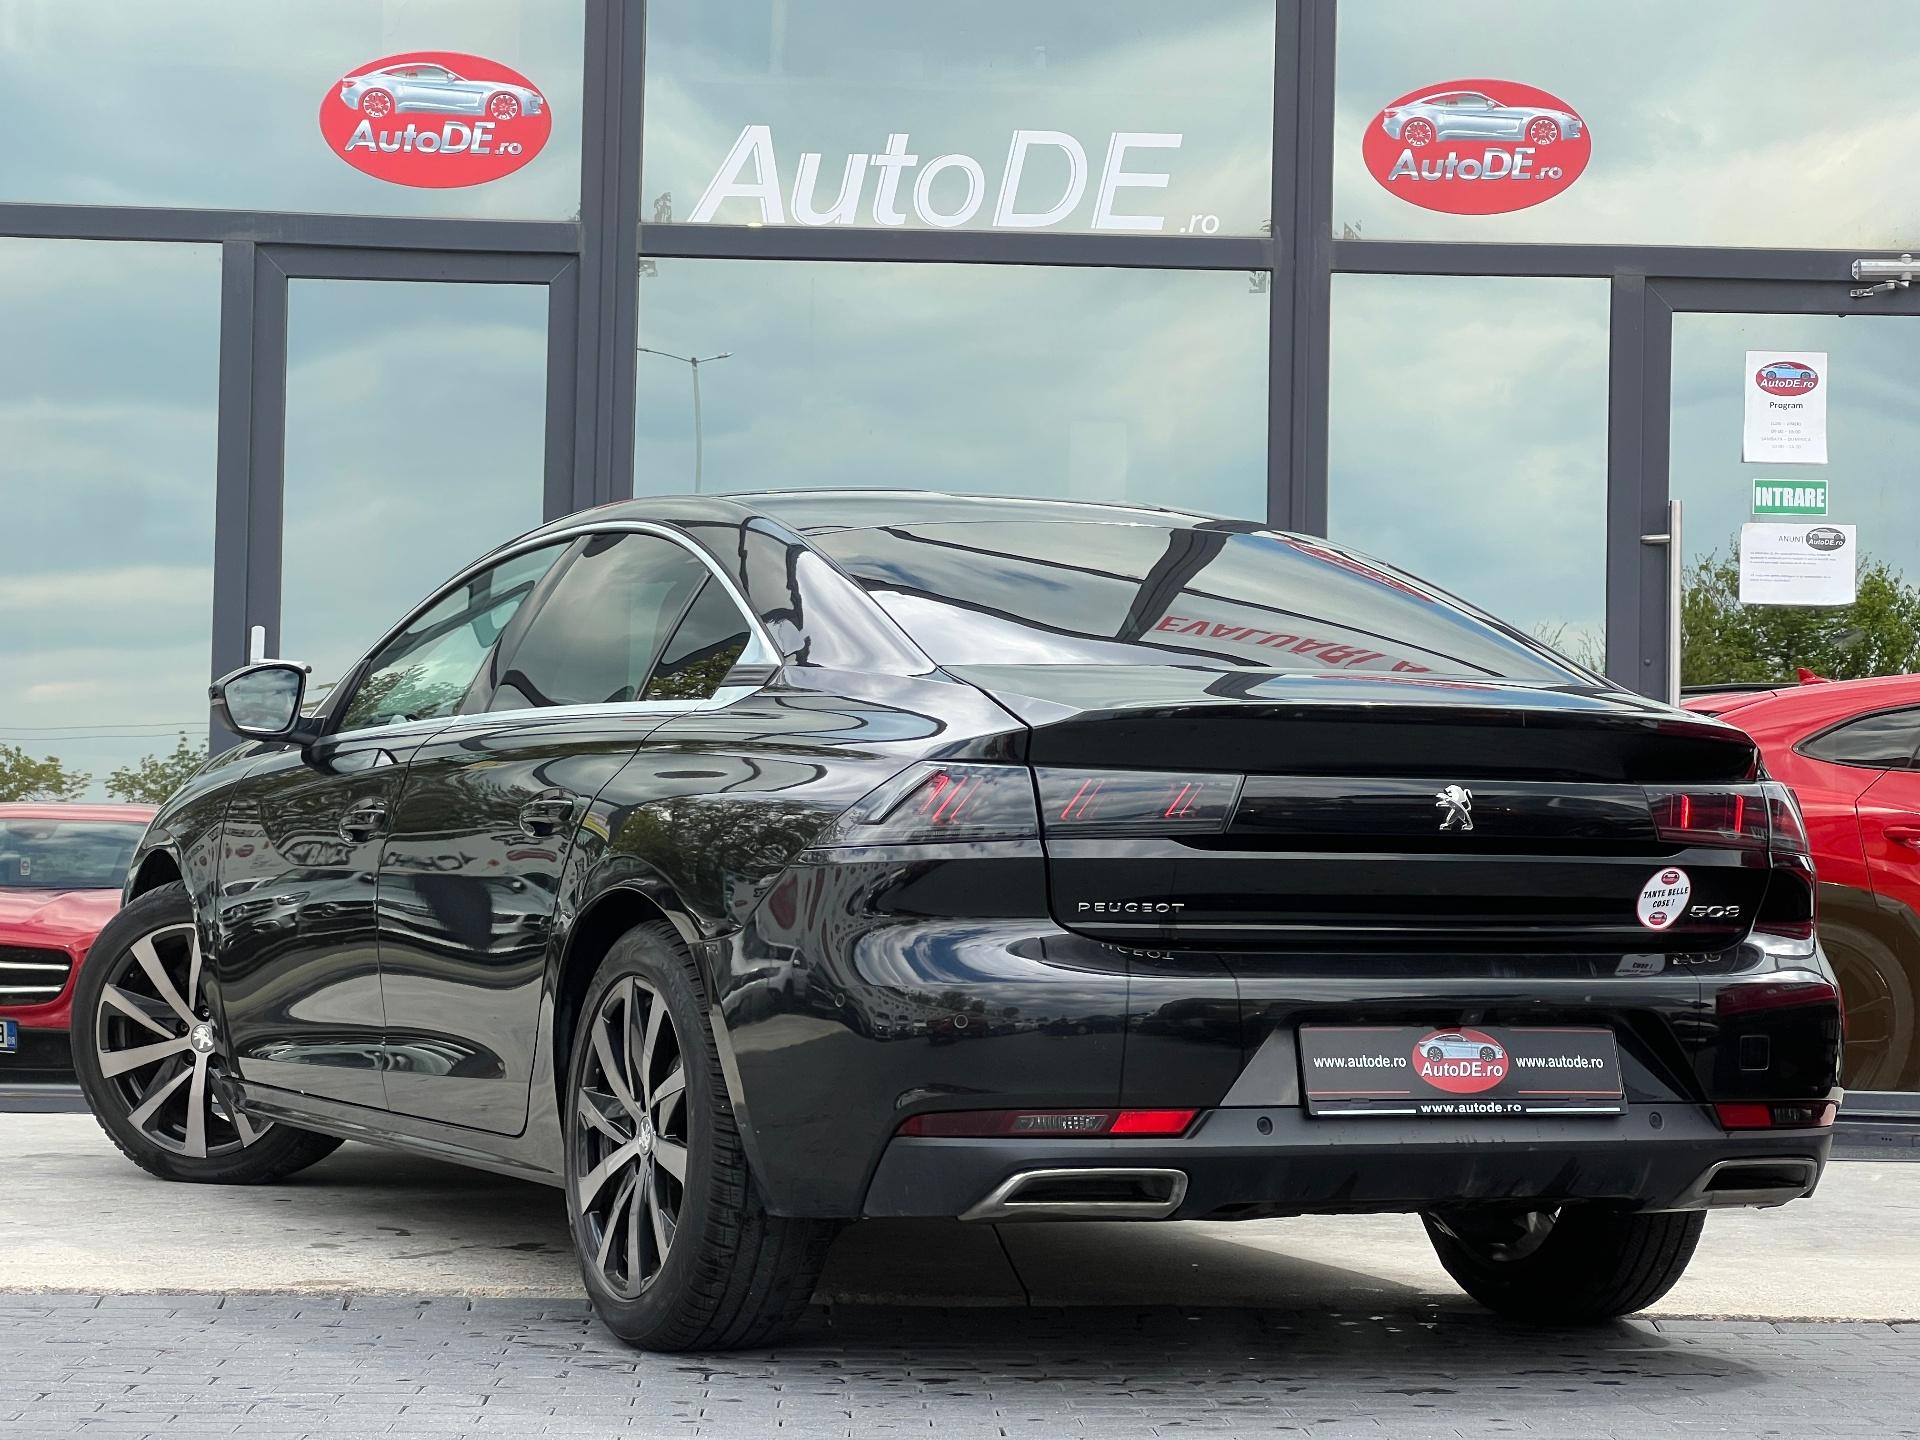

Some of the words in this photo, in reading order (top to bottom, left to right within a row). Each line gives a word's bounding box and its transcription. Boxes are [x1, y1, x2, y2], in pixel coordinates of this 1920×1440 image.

[1760, 378, 1815, 388] AutoDE.ro
[1769, 401, 1804, 411] Program
[1755, 486, 1825, 508] INTRARE
[1643, 890, 1666, 899] TANTE
[1667, 886, 1689, 897] BELLE
[1078, 902, 1185, 913] PEUGEOT
[1689, 905, 1740, 918] 508
[1313, 1055, 1407, 1069] www.autode.ro
[1515, 1055, 1604, 1069] www.autode.ro
[1421, 1061, 1504, 1078] AutoDE.ro
[1420, 1102, 1522, 1114] www.autode.ro
